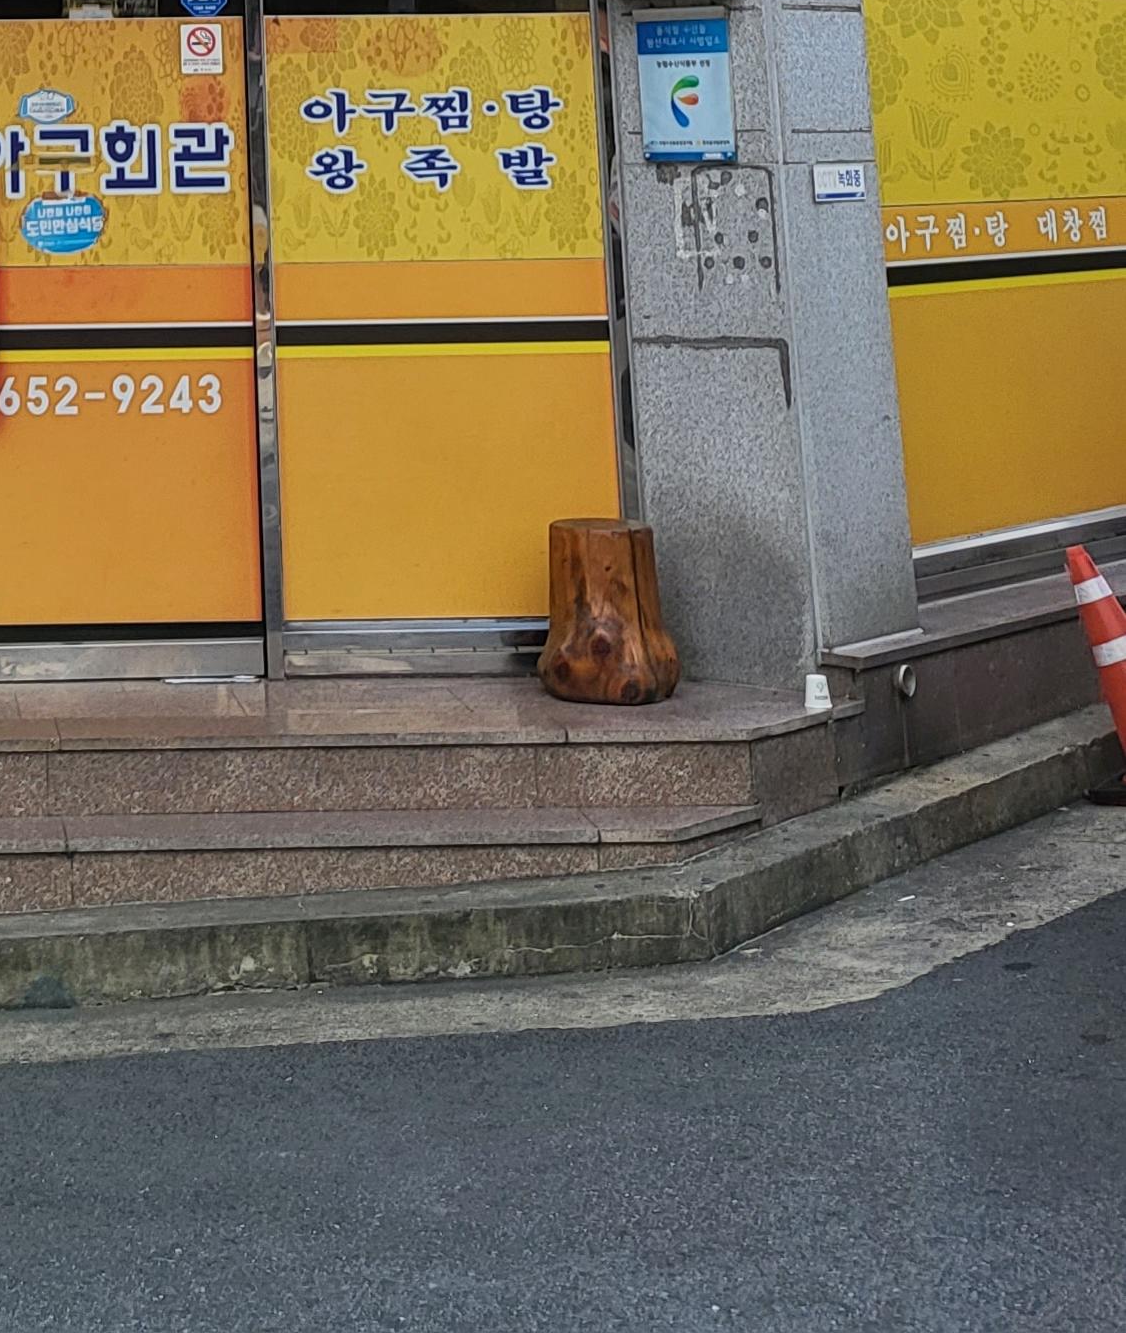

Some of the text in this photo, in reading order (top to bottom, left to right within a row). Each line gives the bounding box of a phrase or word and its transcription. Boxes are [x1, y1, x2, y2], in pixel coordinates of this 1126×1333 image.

[300, 86, 562, 133] 아구찜·탕
[885, 205, 1108, 254] 아구찜·탕 대창찜
